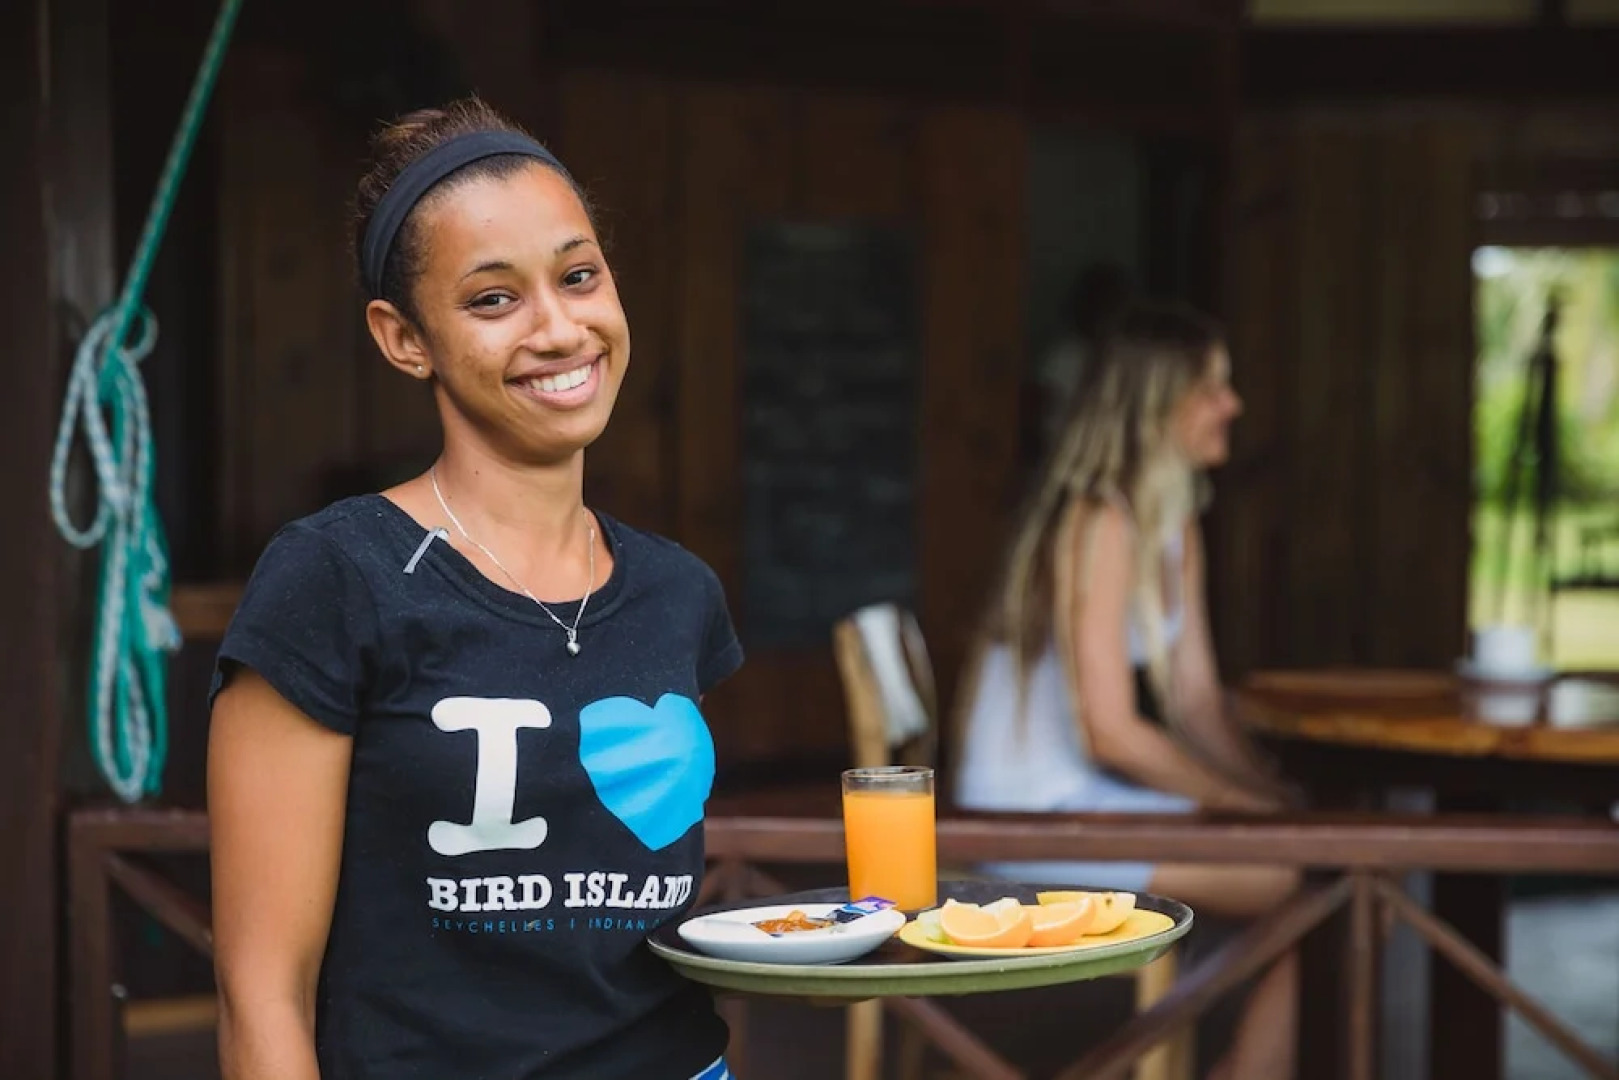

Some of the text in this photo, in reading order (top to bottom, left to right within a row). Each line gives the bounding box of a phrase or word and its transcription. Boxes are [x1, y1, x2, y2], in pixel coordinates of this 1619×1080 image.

[428, 697, 552, 856] I
[426, 871, 694, 912] BIRD ISLAND
[432, 917, 555, 934] SEYCHELLES
[588, 917, 647, 931] INDIAN
